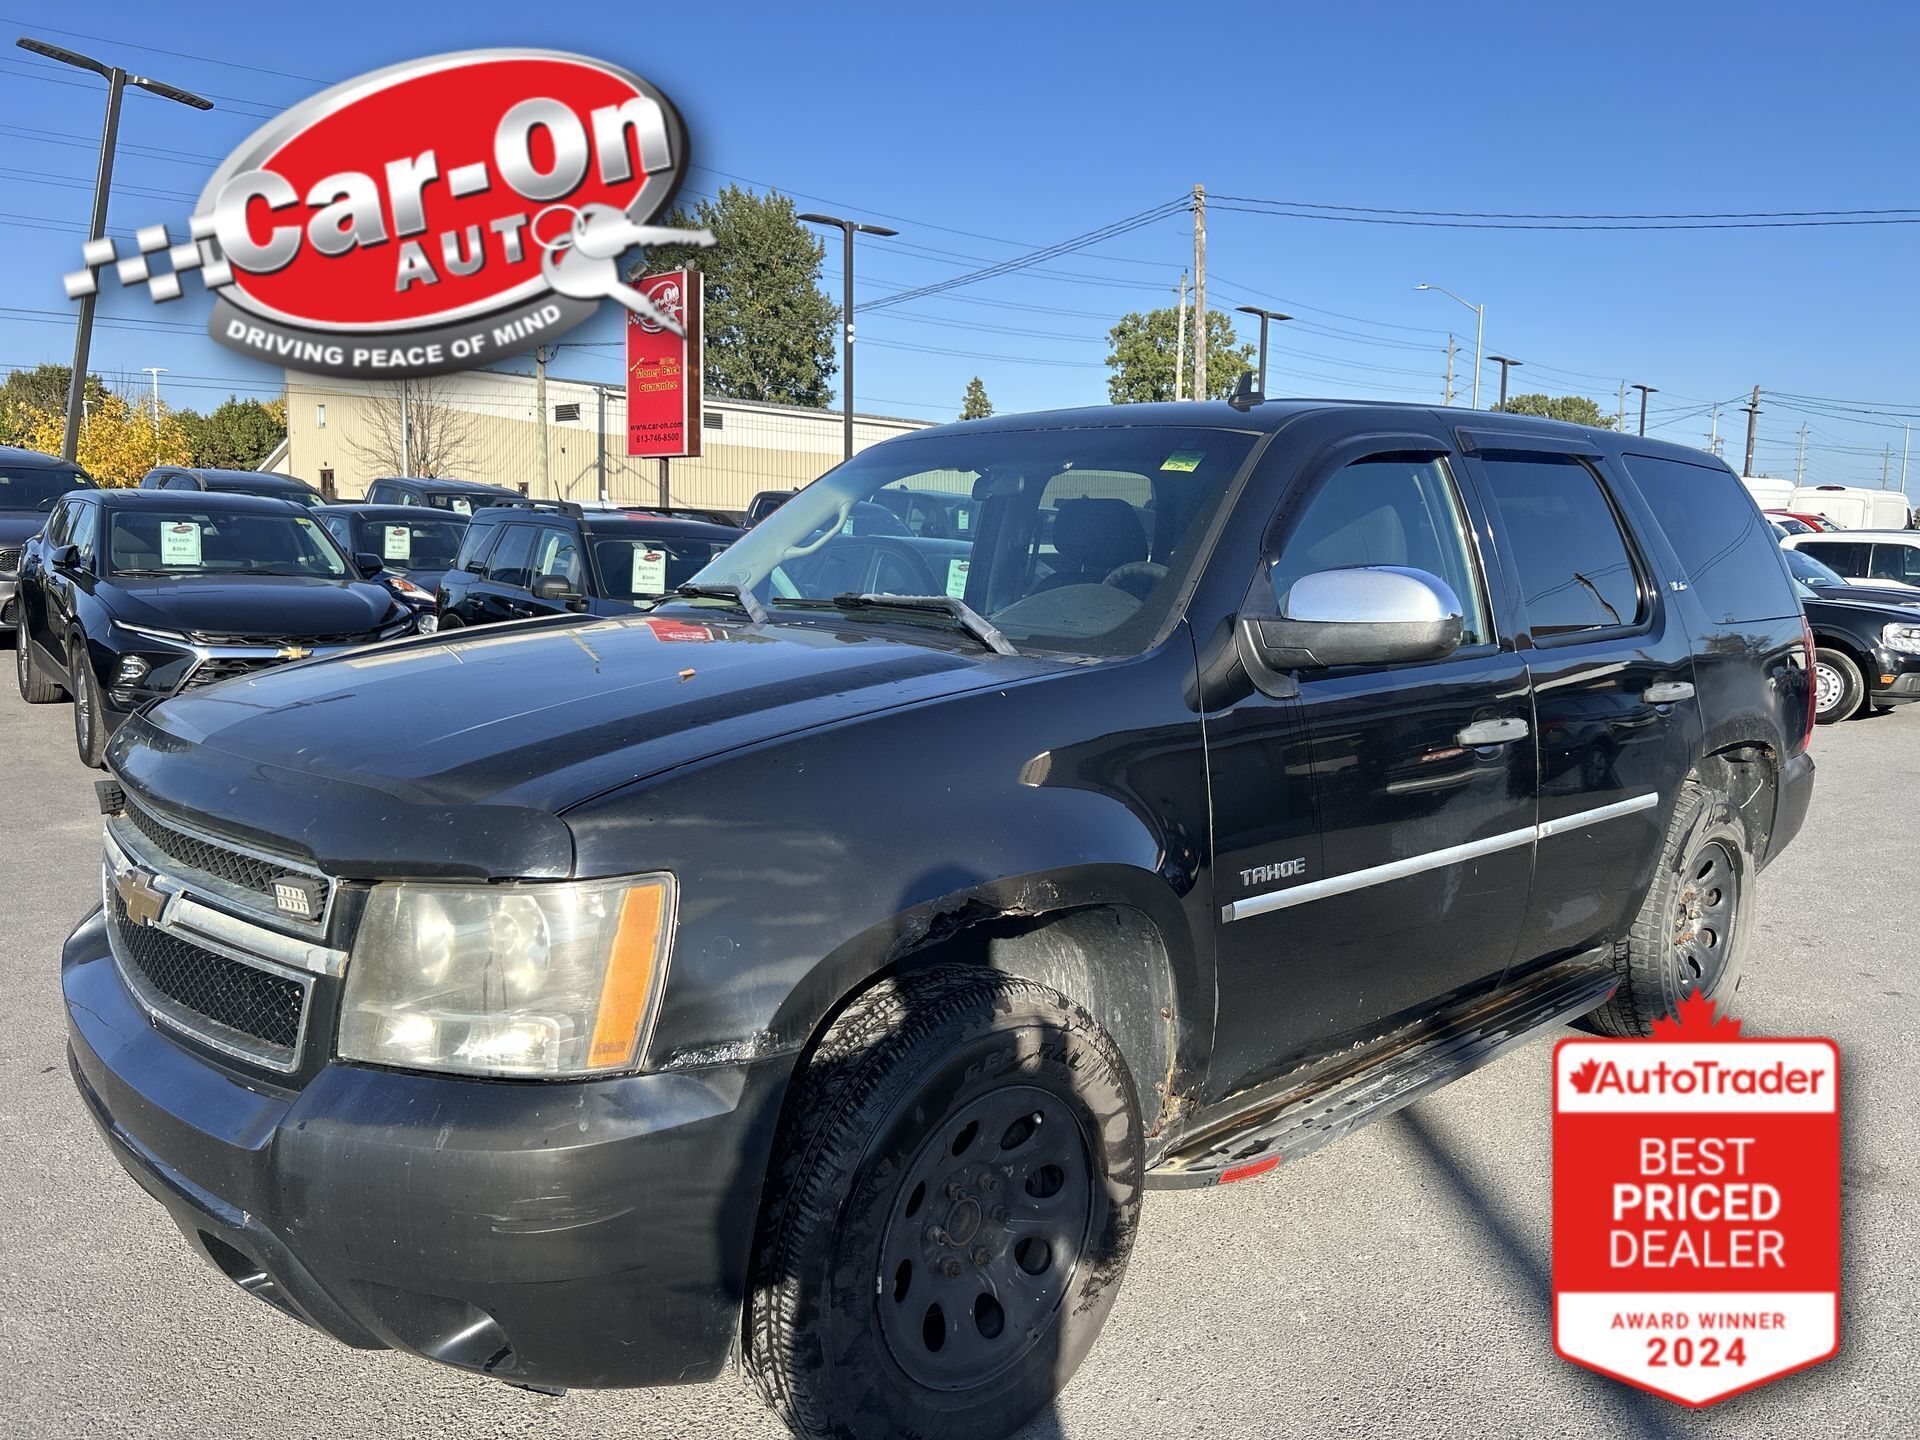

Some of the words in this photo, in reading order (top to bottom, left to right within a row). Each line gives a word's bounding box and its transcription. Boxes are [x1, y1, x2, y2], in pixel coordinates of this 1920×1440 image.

[636, 368, 661, 379] Money
[662, 364, 681, 376] Back
[640, 380, 678, 392] Guarantee
[630, 421, 683, 431] www.car-on.com
[636, 432, 680, 443] 613-746-8500
[1239, 857, 1306, 887] TAHOE
